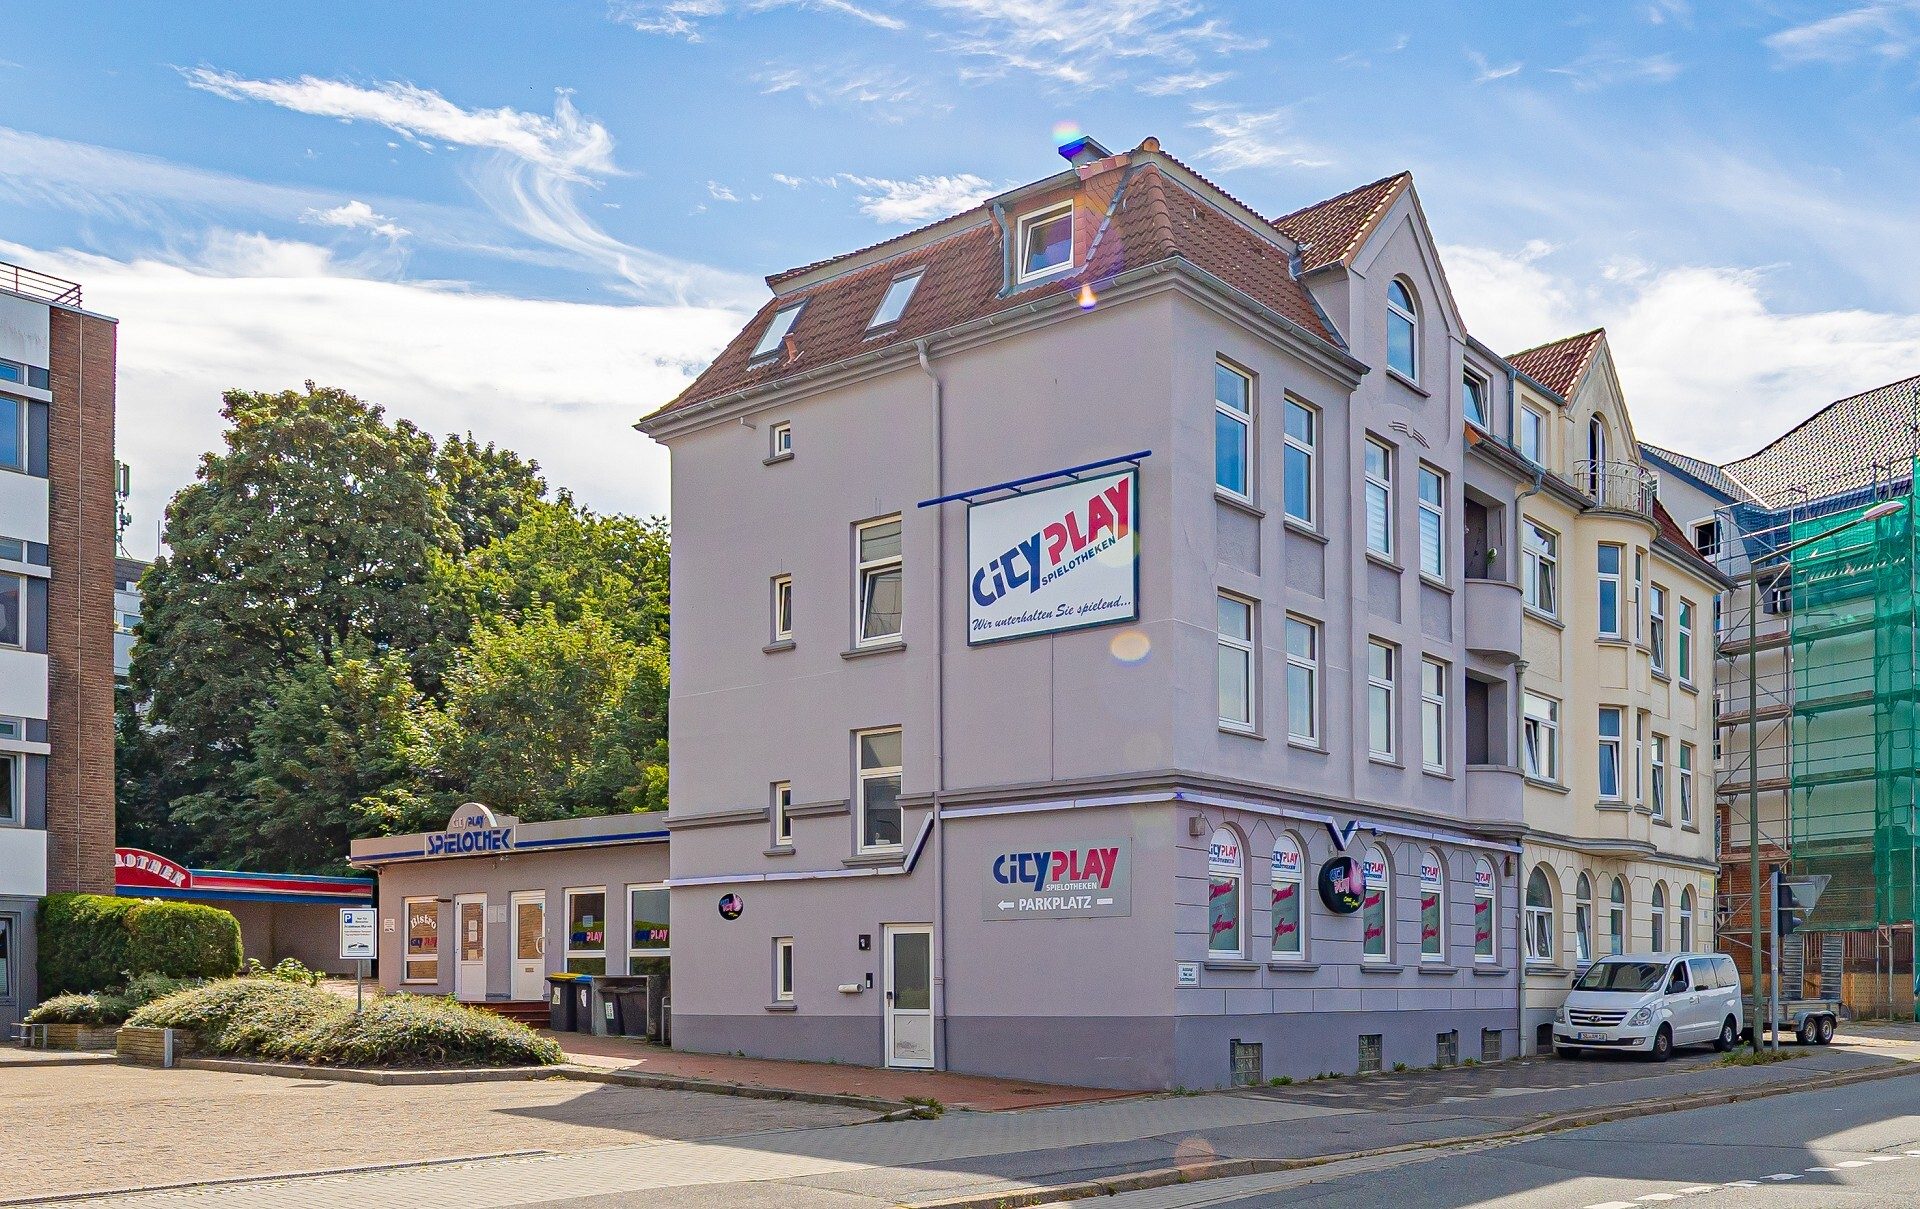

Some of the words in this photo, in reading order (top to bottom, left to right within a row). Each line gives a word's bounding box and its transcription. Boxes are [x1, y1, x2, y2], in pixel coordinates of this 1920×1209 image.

[1041, 535, 1116, 586] SPIELOTHEKEN
[972, 618, 993, 631] Wir
[995, 608, 1053, 627] unterhalten
[1056, 603, 1074, 618] Sie
[1046, 881, 1098, 892] SPIELOTHEKEN
[1018, 895, 1092, 911] PARKPLATZ
[345, 914, 352, 923] P
[411, 915, 437, 930] Bistro
